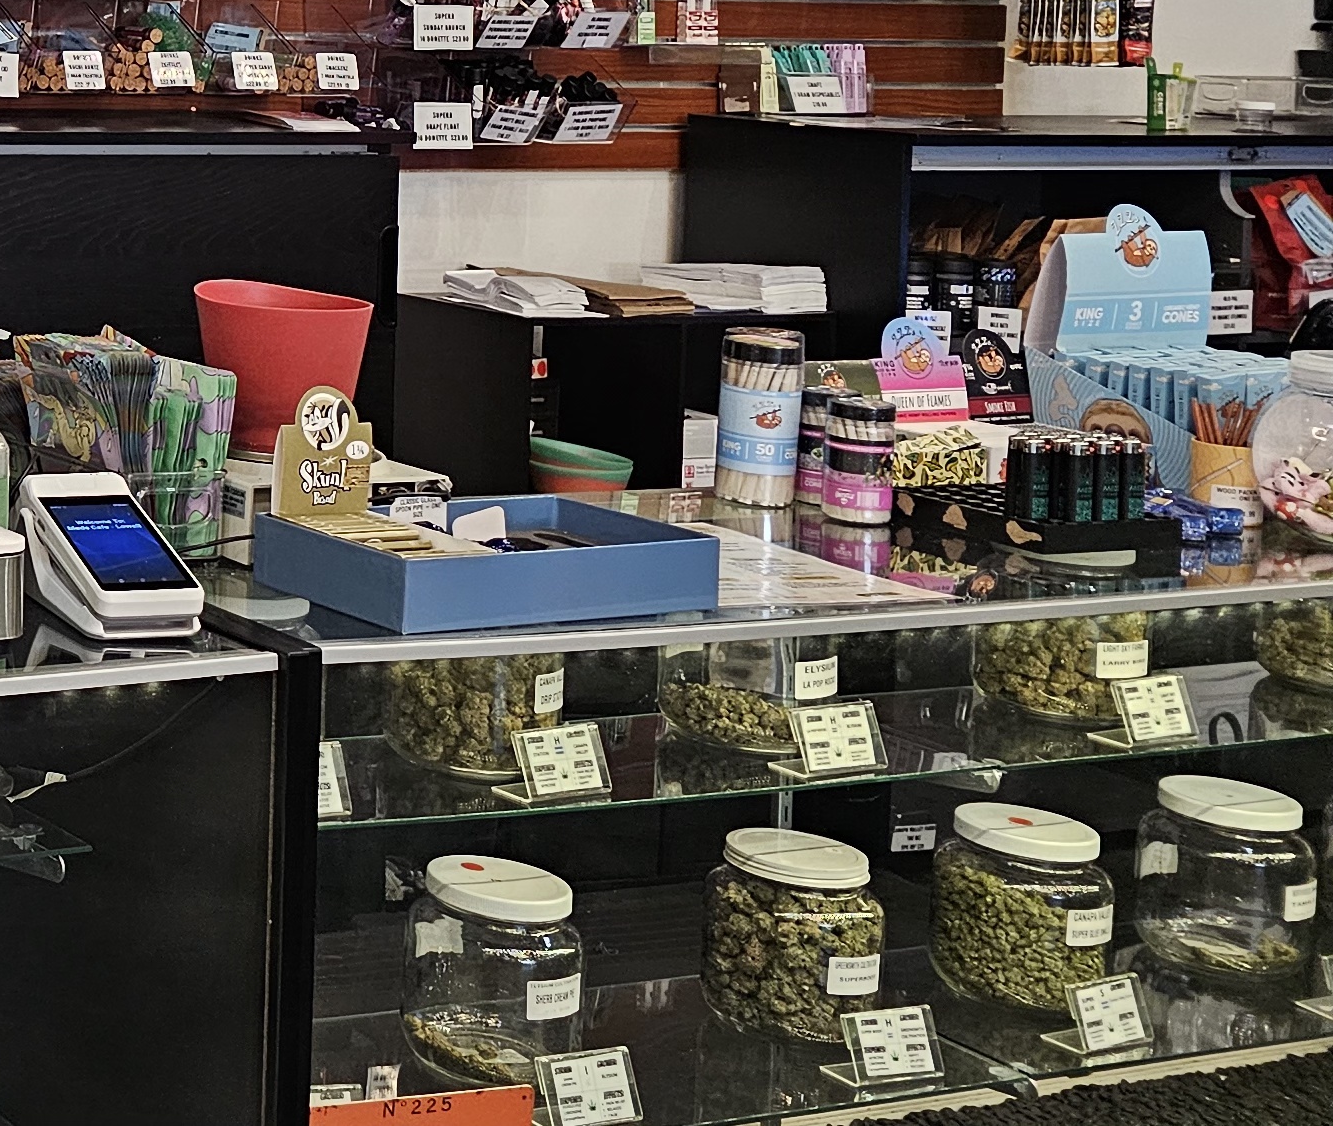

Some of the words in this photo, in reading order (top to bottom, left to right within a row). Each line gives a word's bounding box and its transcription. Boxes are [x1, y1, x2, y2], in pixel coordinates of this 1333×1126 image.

[1074, 306, 1104, 320] KING
[1129, 300, 1142, 321] 3
[1161, 309, 1200, 324] CONES
[916, 394, 925, 407] OF
[926, 393, 952, 407] FLAMES
[754, 443, 775, 456] 50
